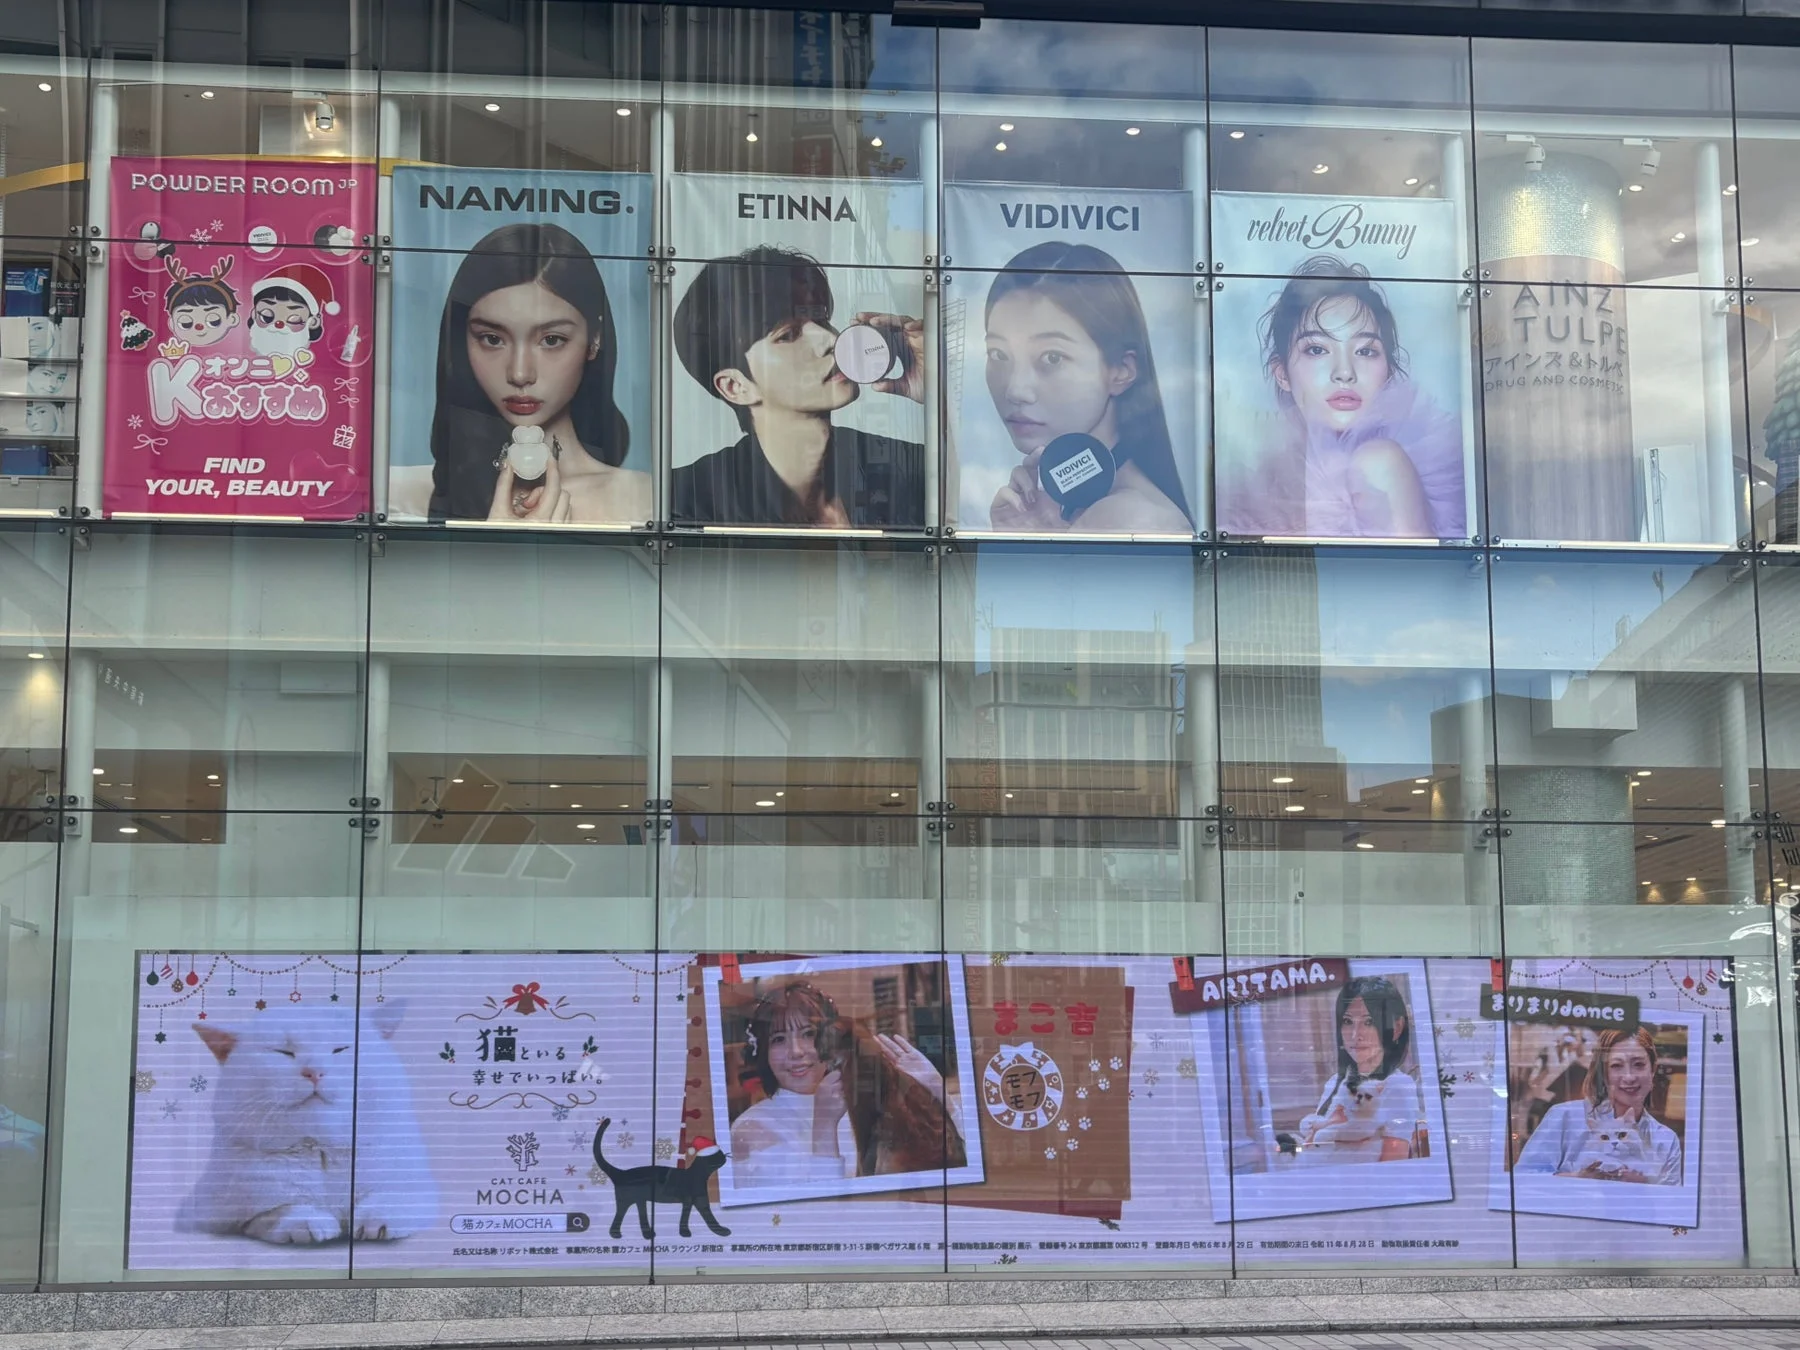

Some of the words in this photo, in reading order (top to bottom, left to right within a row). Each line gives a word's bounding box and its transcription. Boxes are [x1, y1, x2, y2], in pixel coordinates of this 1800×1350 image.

[131, 173, 245, 194] POWDER
[252, 176, 335, 196] ROOM
[338, 179, 359, 190] JP
[419, 184, 635, 215] NAMING.
[738, 193, 857, 222] ETINNA
[1000, 203, 1139, 231] VIDIVICI
[1246, 206, 1308, 242] velvet
[1302, 203, 1417, 260] Bunny
[1513, 280, 1614, 313] AINZ
[1513, 315, 1627, 355] TULPE
[1484, 376, 1526, 392] DRUG
[1532, 374, 1565, 386] AND
[201, 382, 327, 420] おすすめ
[203, 457, 266, 474] FIND
[1055, 454, 1092, 479] VIDIVICI
[145, 479, 221, 498] YOUR,
[227, 479, 335, 497] BEAUTY
[1202, 962, 1336, 1002] ARITAMA.
[993, 1001, 1099, 1036] まこ吉
[1491, 992, 1626, 1021] まりまりdance
[475, 1025, 567, 1062] 猫といる
[1006, 1071, 1037, 1089] モフ
[1009, 1092, 1041, 1109] モフ
[517, 1177, 547, 1185] CAFE
[476, 1189, 564, 1205] MOCHA
